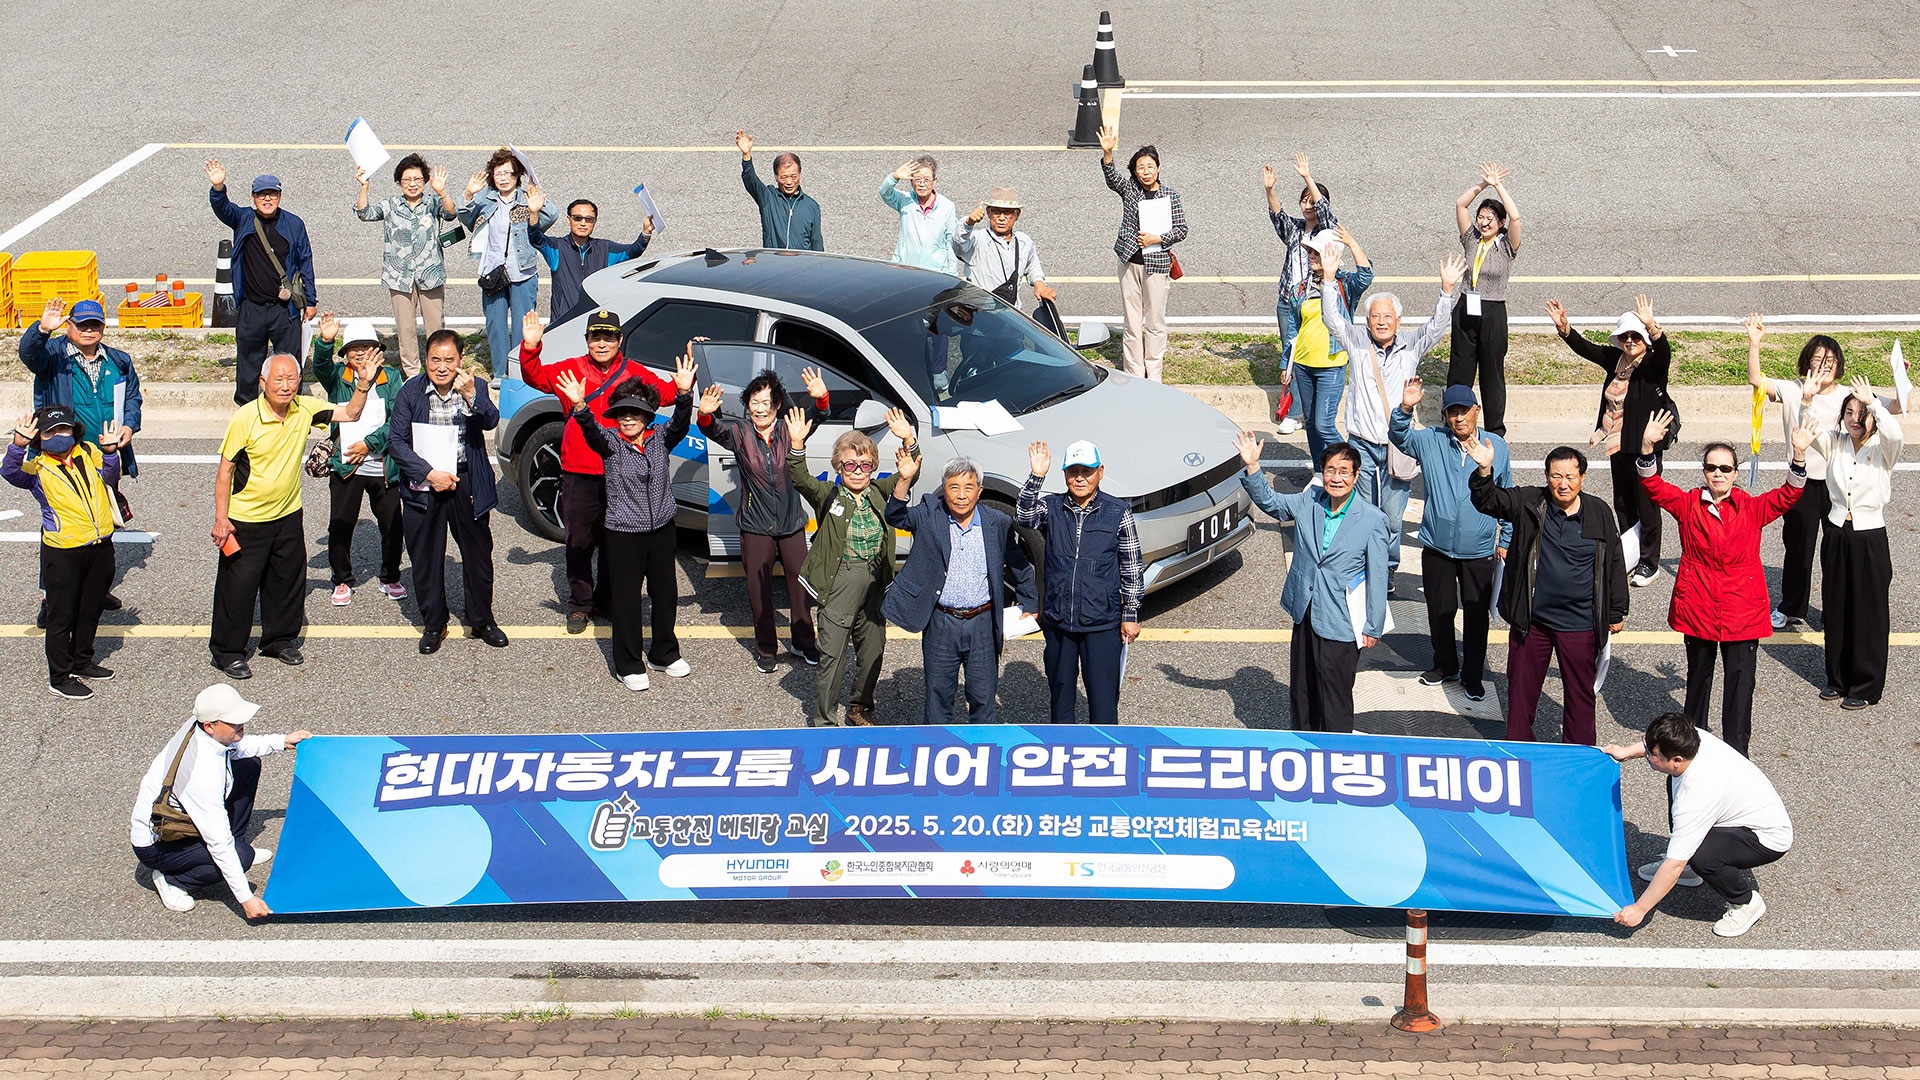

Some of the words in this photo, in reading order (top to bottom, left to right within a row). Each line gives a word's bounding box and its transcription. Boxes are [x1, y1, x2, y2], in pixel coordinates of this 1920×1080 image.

[686, 435, 705, 450] TS
[1198, 508, 1231, 545] 104
[379, 749, 794, 802] 현대자동차그룹
[811, 746, 990, 788] 시니어
[1011, 746, 1127, 788] 안전
[1147, 748, 1387, 798] 드라이빙
[1406, 756, 1522, 807] 데이
[632, 815, 712, 845] 교통안전
[719, 815, 781, 844] 베테랑
[786, 814, 828, 843] 교실
[844, 815, 917, 836] 2025.
[922, 815, 945, 836] 5.
[951, 813, 1033, 838] 20.(화)
[1038, 814, 1082, 838] 화성
[1087, 815, 1308, 842] 교통안전체험교육센터
[726, 858, 790, 870] HYUNDAI
[846, 860, 934, 873] 한국노인종합복지관협회
[977, 860, 1032, 873] 사랑의열매
[1063, 861, 1095, 877] TS
